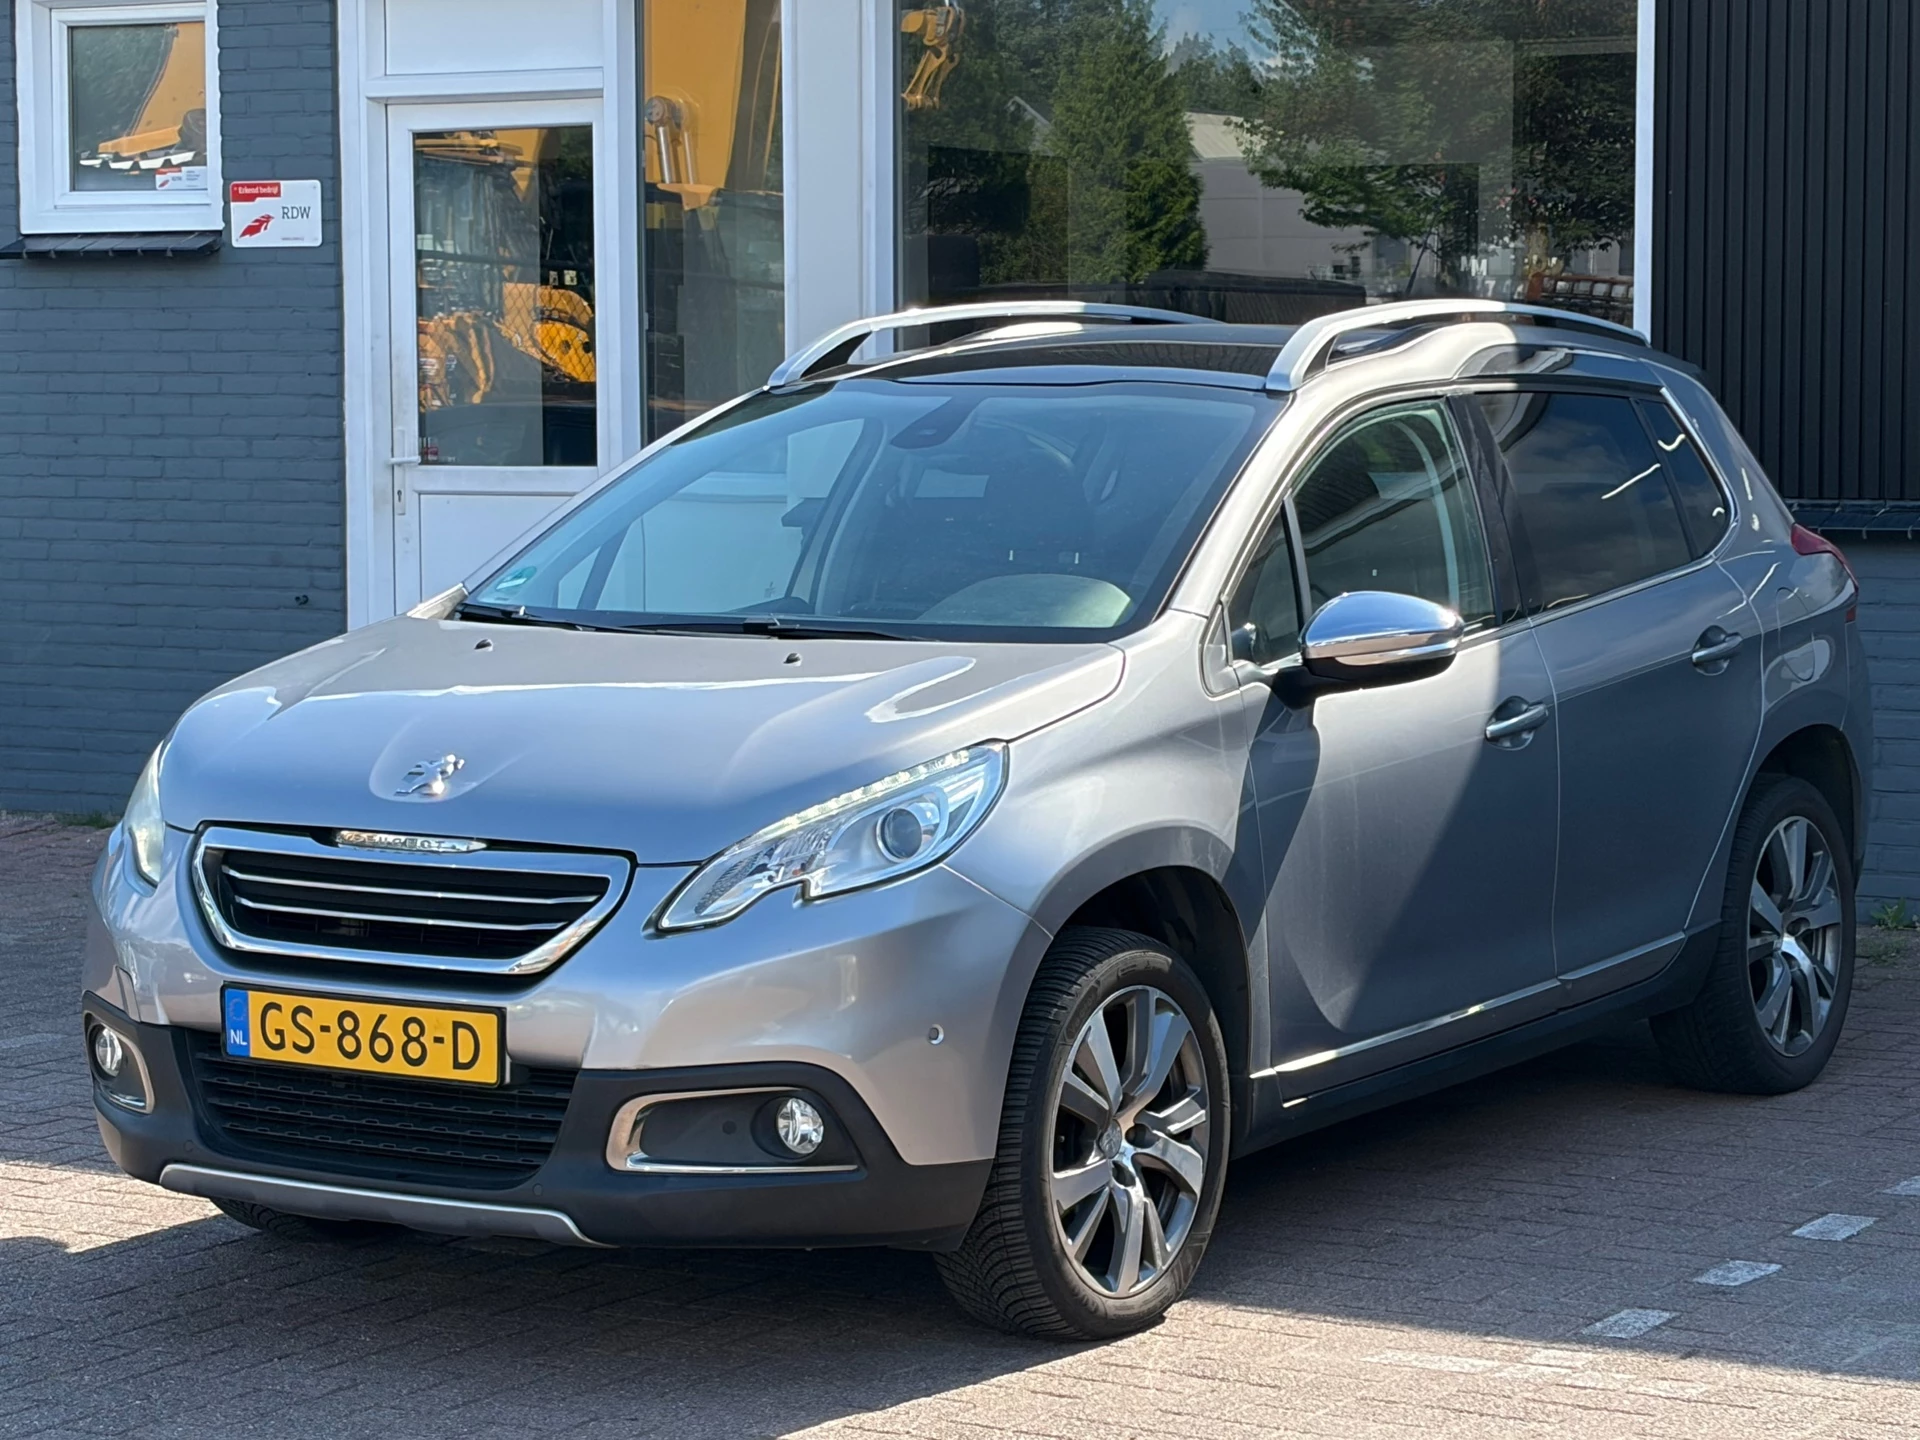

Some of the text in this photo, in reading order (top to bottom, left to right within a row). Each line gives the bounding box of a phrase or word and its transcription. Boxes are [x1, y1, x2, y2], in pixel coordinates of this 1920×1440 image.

[238, 186, 259, 194] Erkend
[281, 206, 311, 220] RDW
[230, 1028, 248, 1046] NL
[260, 1001, 481, 1071] GS-868-D
